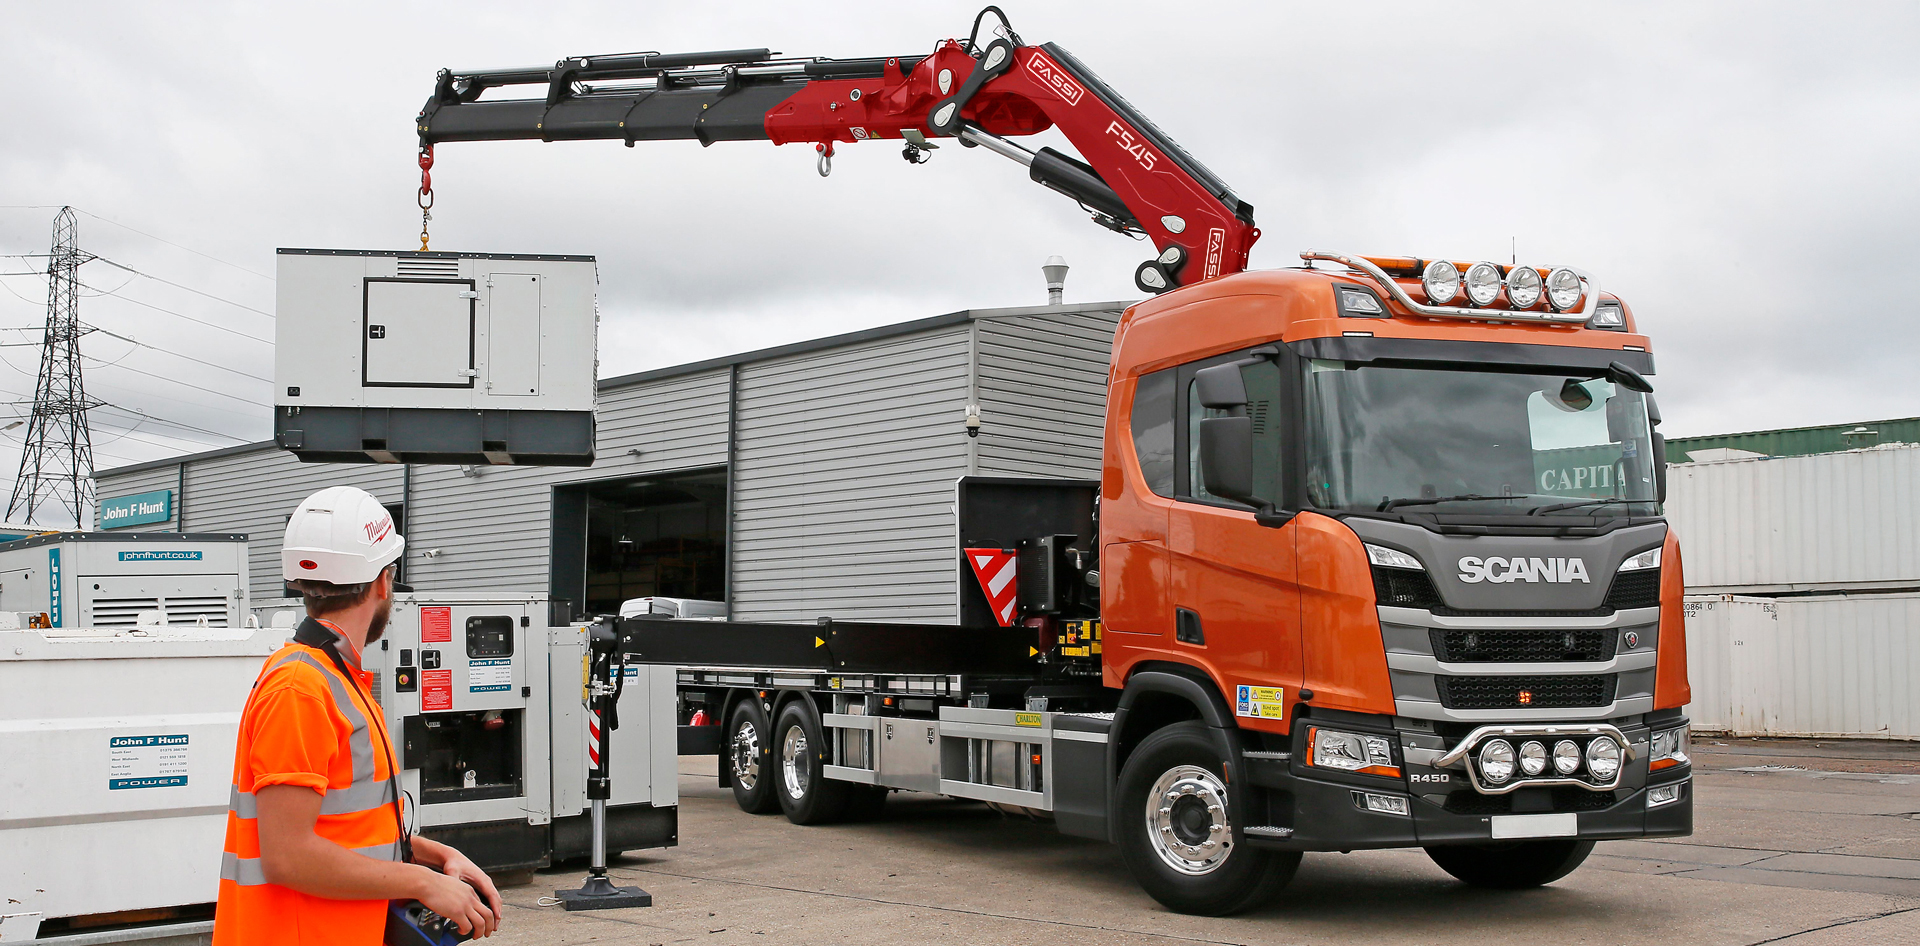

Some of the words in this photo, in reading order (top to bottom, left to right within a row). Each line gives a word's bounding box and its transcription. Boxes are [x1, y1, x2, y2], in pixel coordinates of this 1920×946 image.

[1032, 58, 1078, 100] FASSI
[1105, 120, 1158, 171] F545
[1207, 232, 1221, 279] FASSI
[103, 506, 128, 520] John
[130, 503, 138, 517] F
[138, 501, 164, 516] Hunt
[123, 551, 198, 561] johnfhunt.co.uk
[1457, 556, 1591, 584] SCANIA
[51, 558, 59, 623] John
[1016, 714, 1041, 723] CHARLTON
[118, 779, 180, 787] POWER
[1410, 773, 1450, 783] R450
